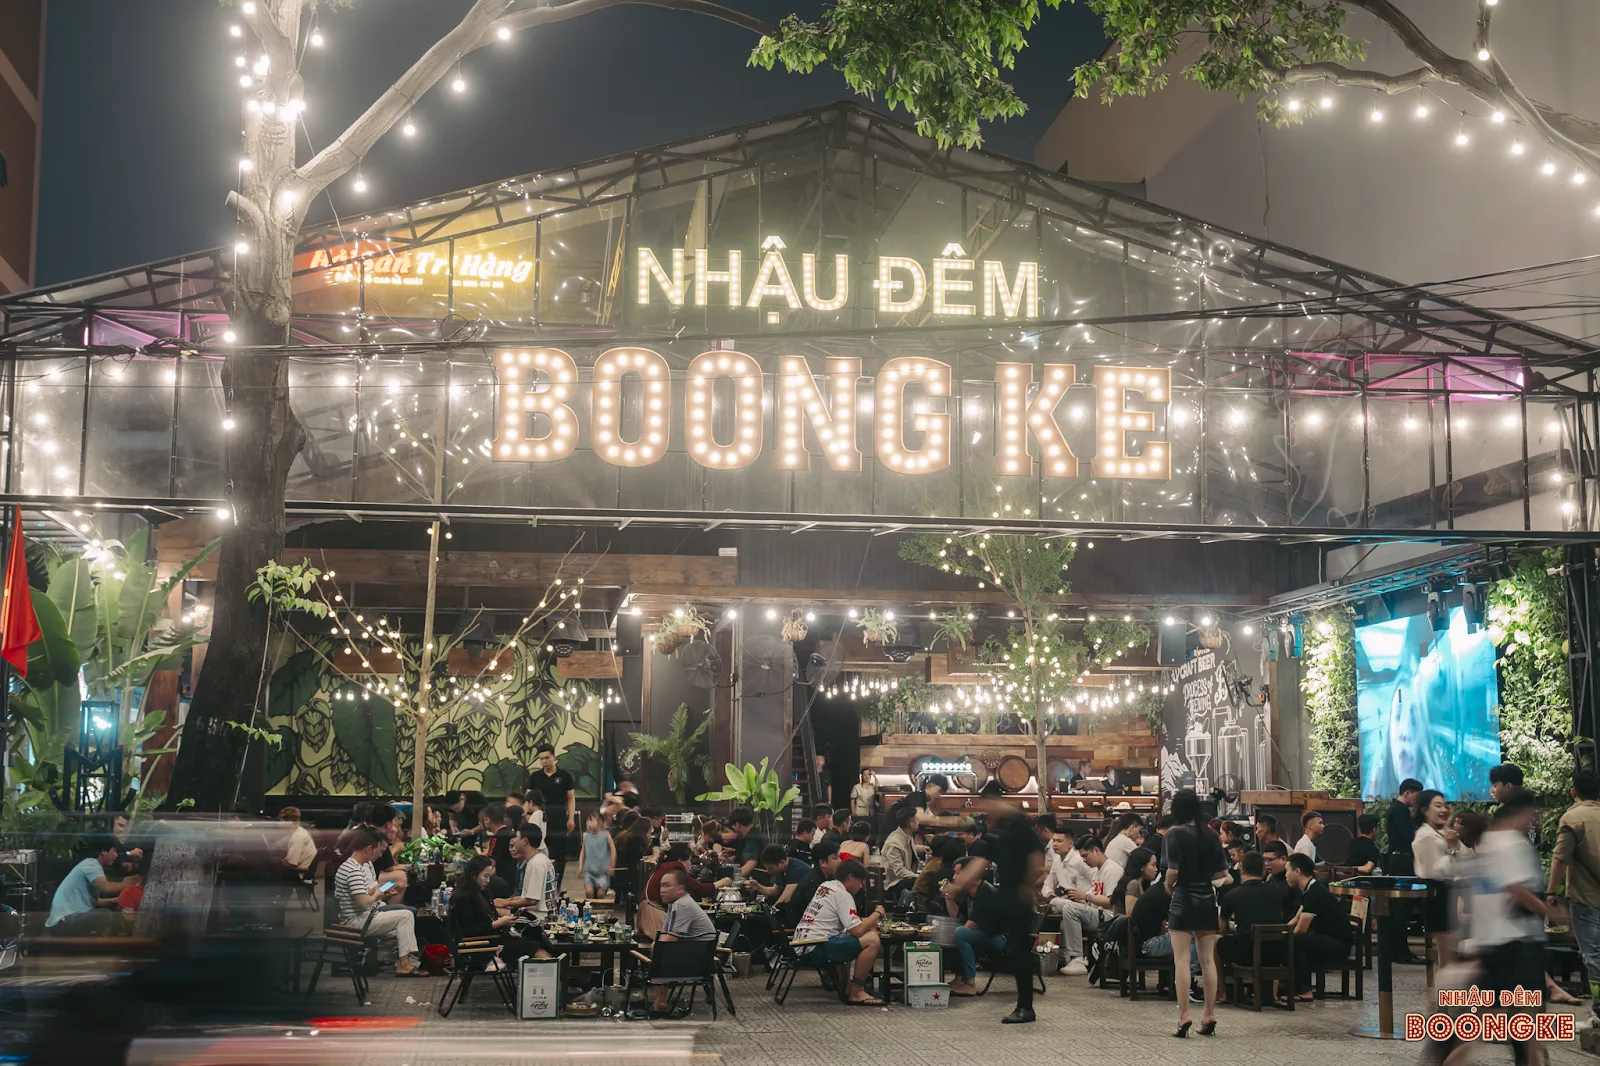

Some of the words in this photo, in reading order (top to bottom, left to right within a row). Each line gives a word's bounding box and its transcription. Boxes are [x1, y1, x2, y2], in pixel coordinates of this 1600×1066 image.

[637, 235, 849, 325] NHẬU
[872, 242, 1039, 318] ĐÊM
[492, 346, 953, 476] BOONG
[994, 361, 1173, 480] KE
[1198, 652, 1216, 673] BEER
